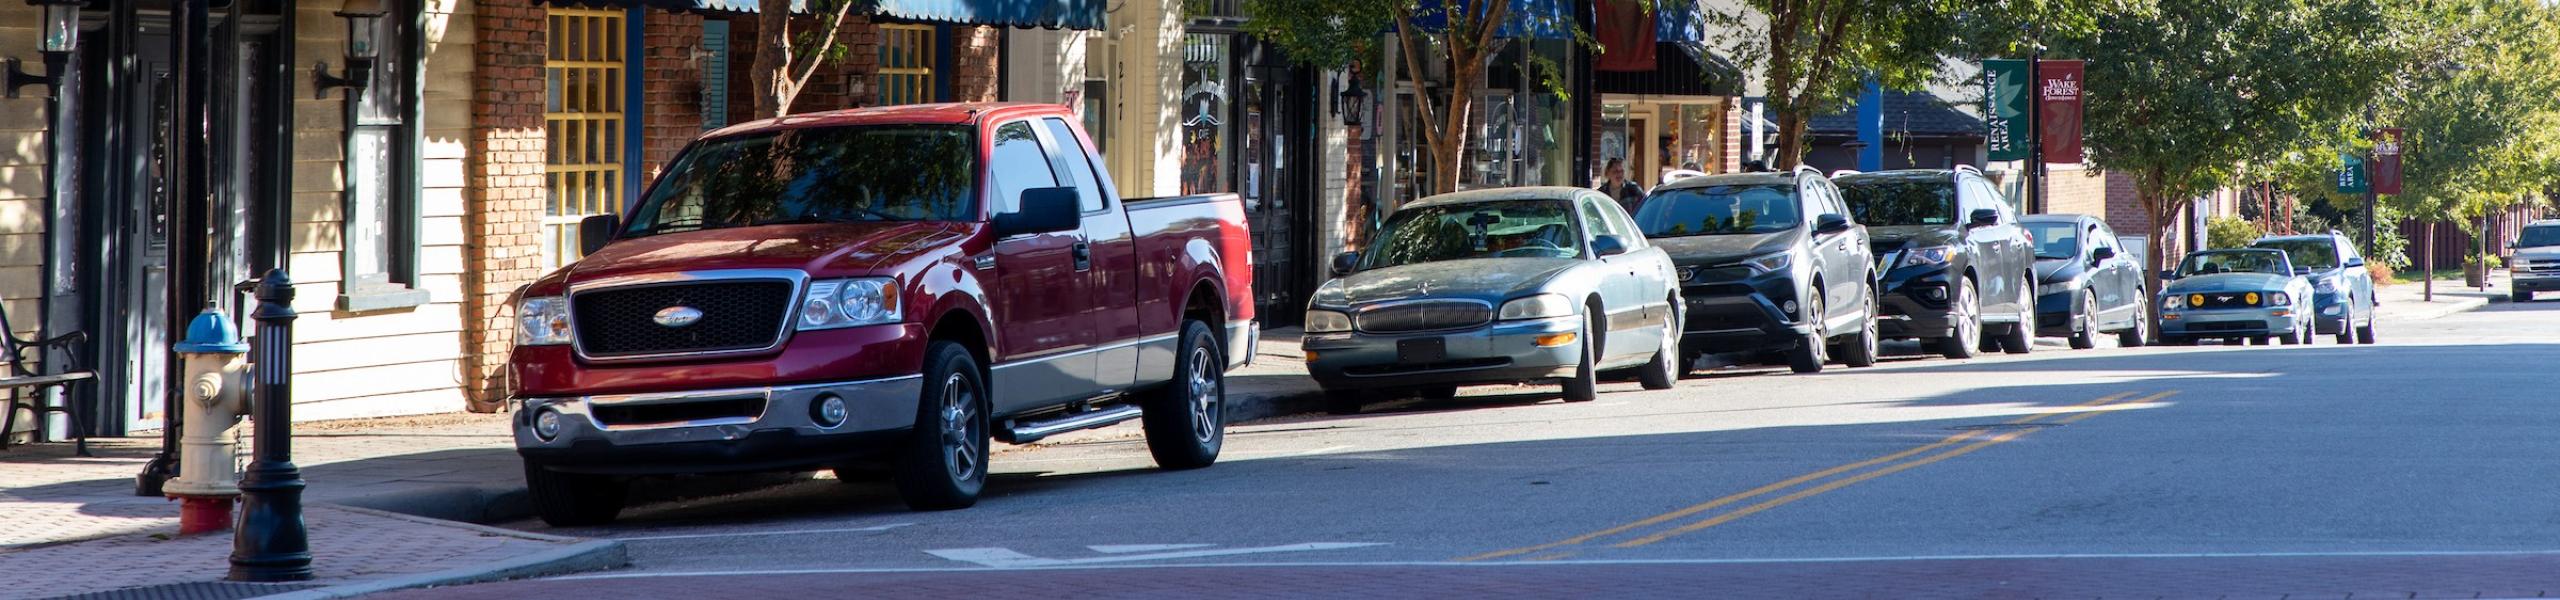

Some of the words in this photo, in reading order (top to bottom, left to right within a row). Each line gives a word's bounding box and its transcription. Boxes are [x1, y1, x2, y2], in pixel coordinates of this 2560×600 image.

[2043, 86, 2079, 96] FOREST
[2048, 79, 2077, 88] WAKE
[1987, 70, 1999, 152] RENAISSANCE
[1999, 120, 2011, 152] AREA
